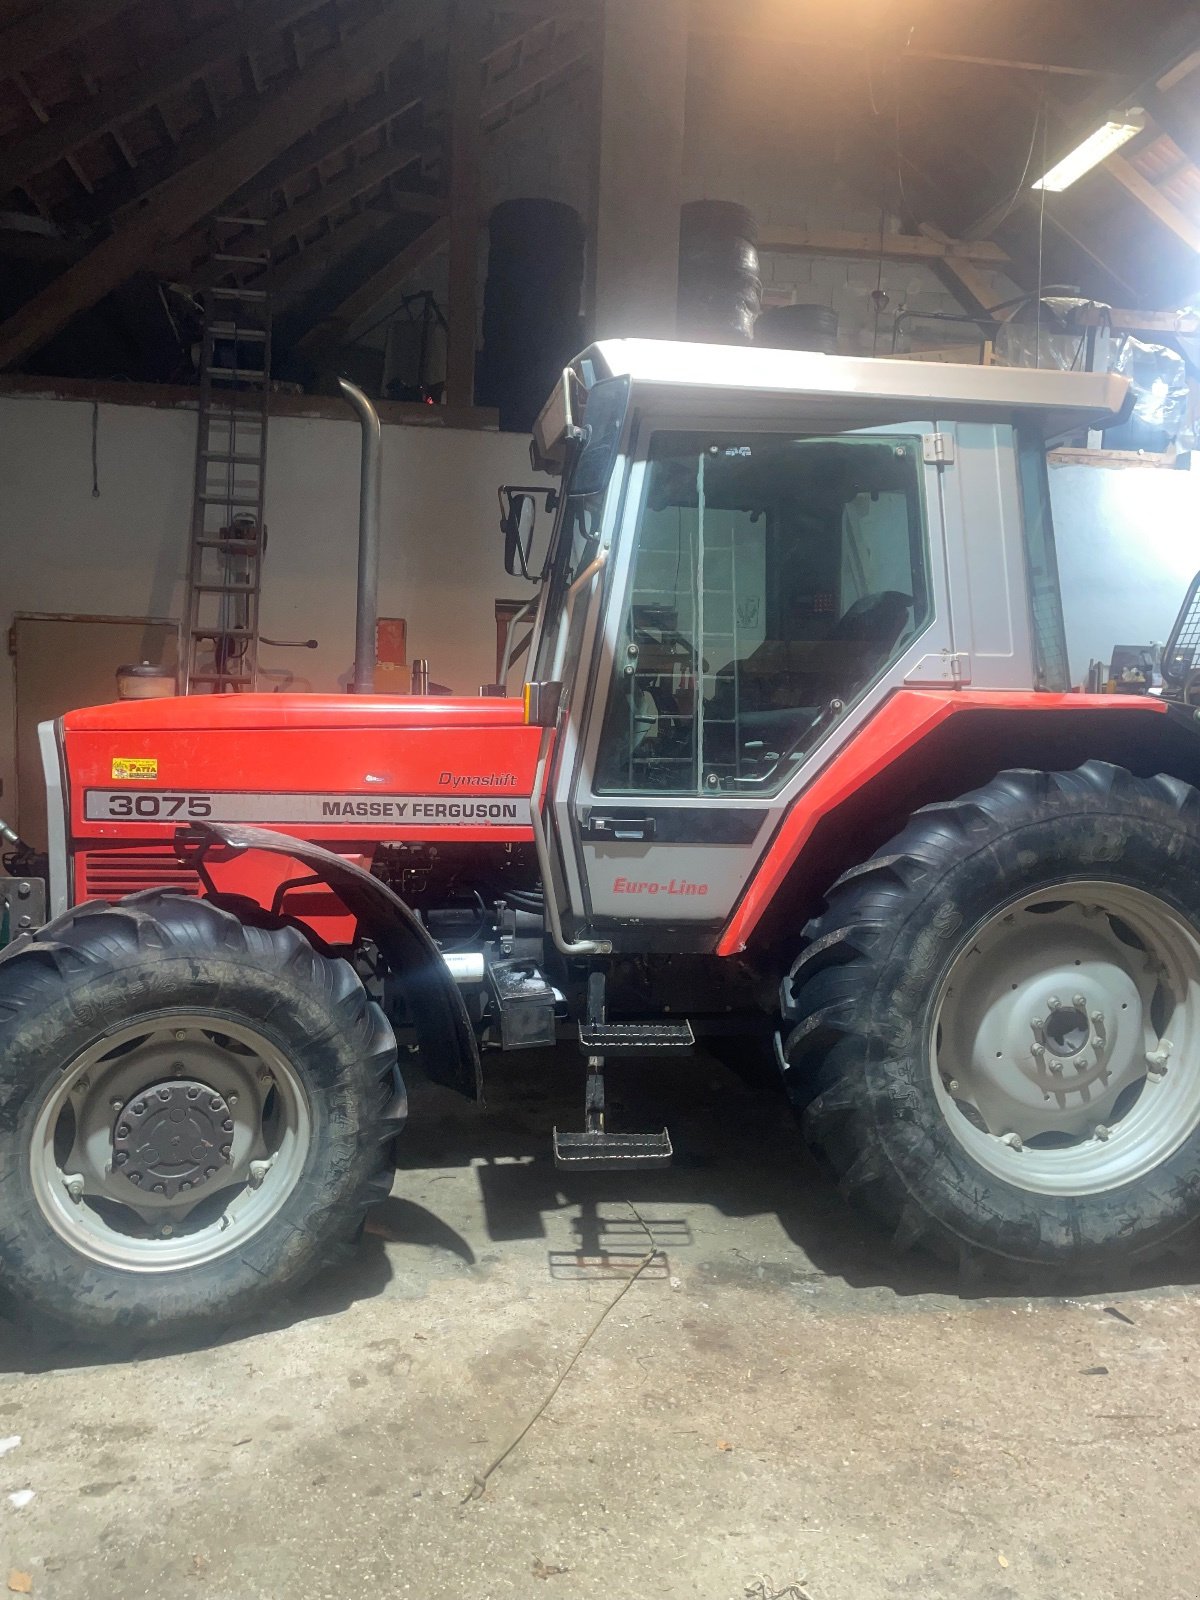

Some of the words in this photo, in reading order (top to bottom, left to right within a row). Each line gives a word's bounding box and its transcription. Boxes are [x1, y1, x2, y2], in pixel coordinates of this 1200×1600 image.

[438, 772, 517, 788] Dynashift
[109, 795, 212, 817] 3075
[322, 801, 409, 817] MASSEY
[412, 803, 517, 818] FERGUSON
